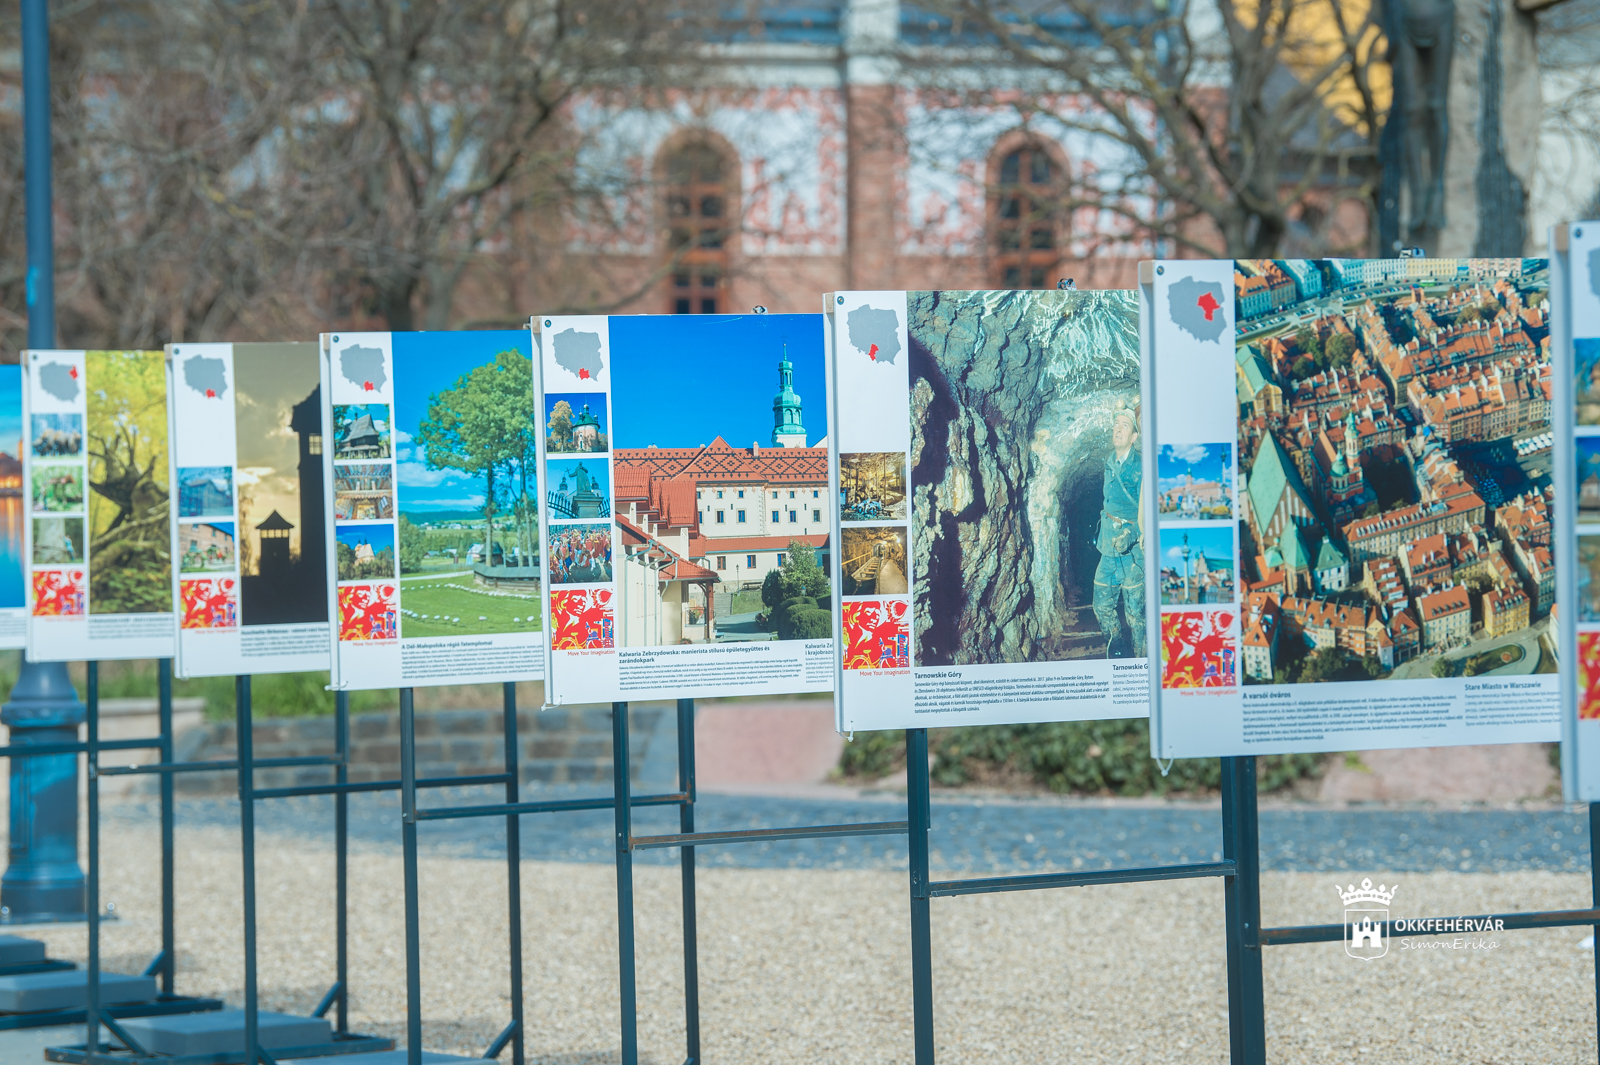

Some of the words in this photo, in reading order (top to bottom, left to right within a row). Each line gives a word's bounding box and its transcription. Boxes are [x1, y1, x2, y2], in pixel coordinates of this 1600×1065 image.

[642, 650, 680, 658] Zebrzydowska:
[726, 645, 764, 654] épületegyüttes
[1208, 688, 1237, 696] Imagination
